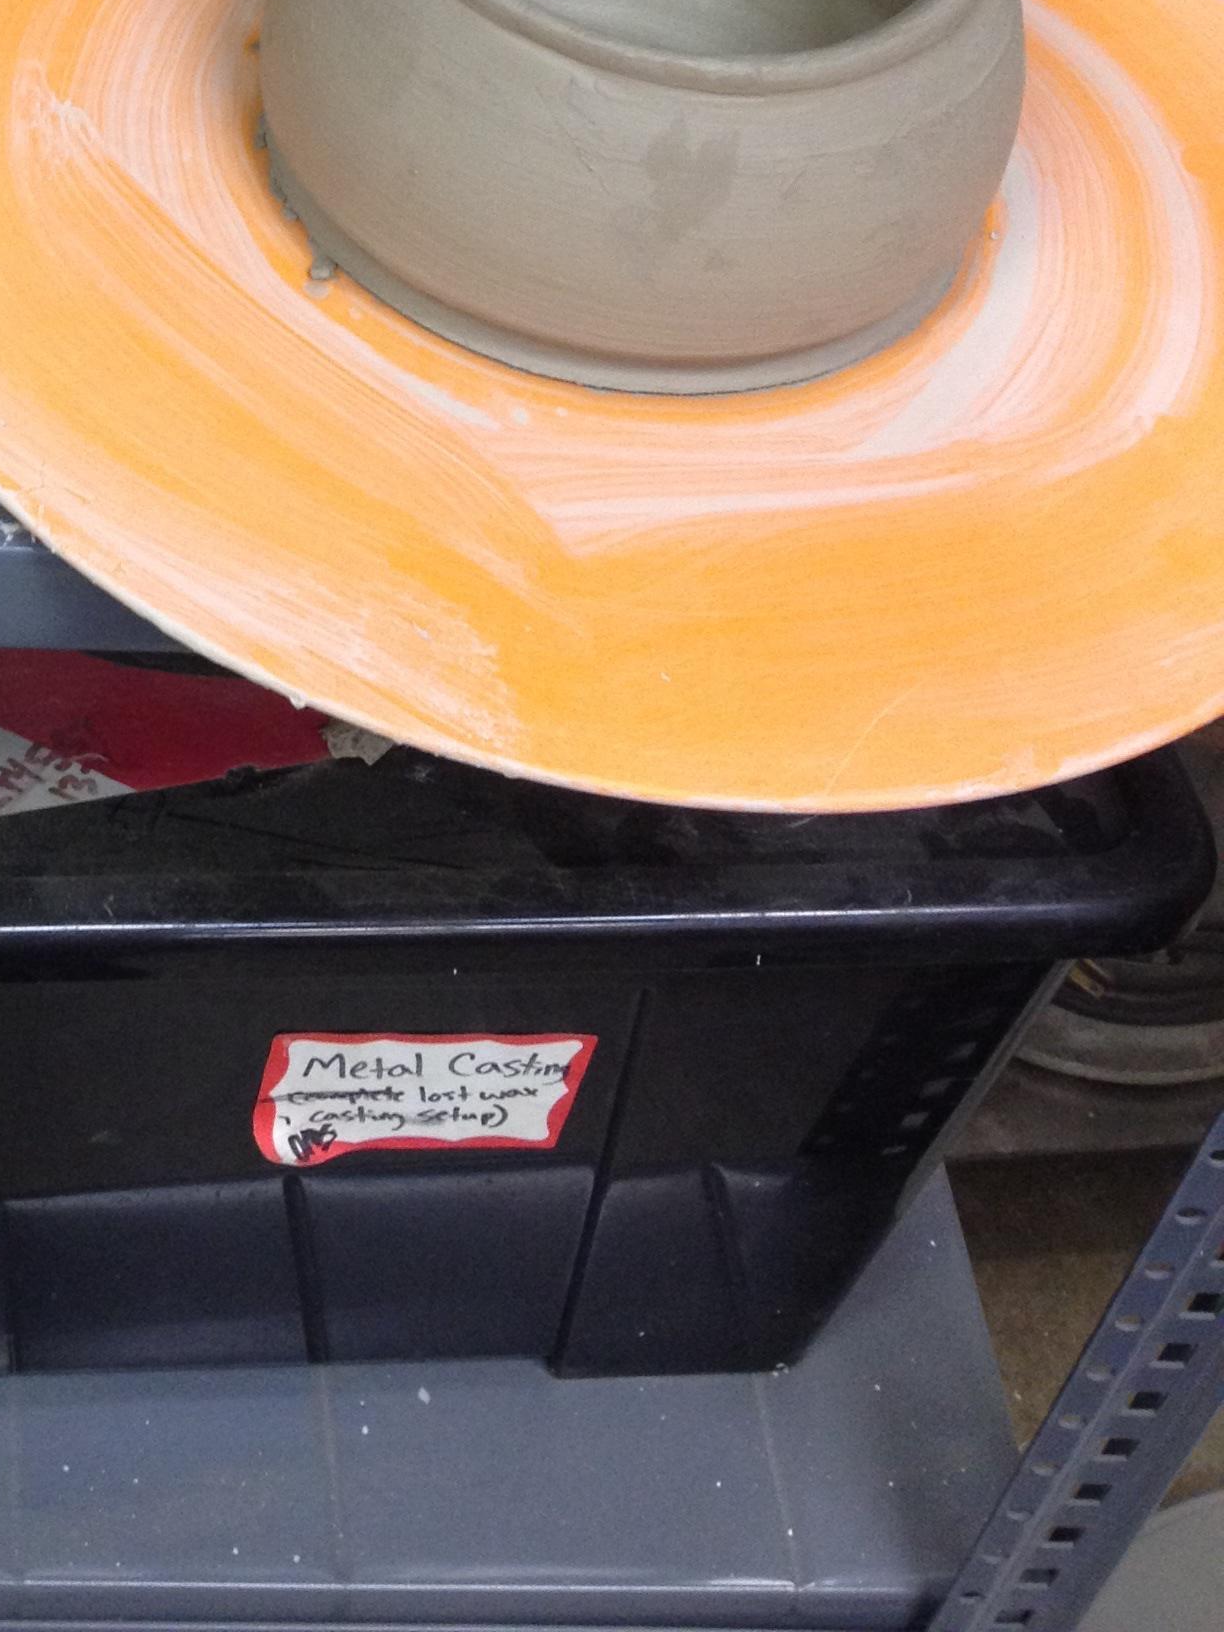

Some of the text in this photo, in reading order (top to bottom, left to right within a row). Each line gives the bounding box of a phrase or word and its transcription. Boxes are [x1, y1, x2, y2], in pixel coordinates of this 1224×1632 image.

[302, 1051, 572, 1086] Metal Casting
[419, 1085, 471, 1103] lost
[479, 1086, 539, 1101] wax
[308, 1103, 509, 1131] casting setup)
